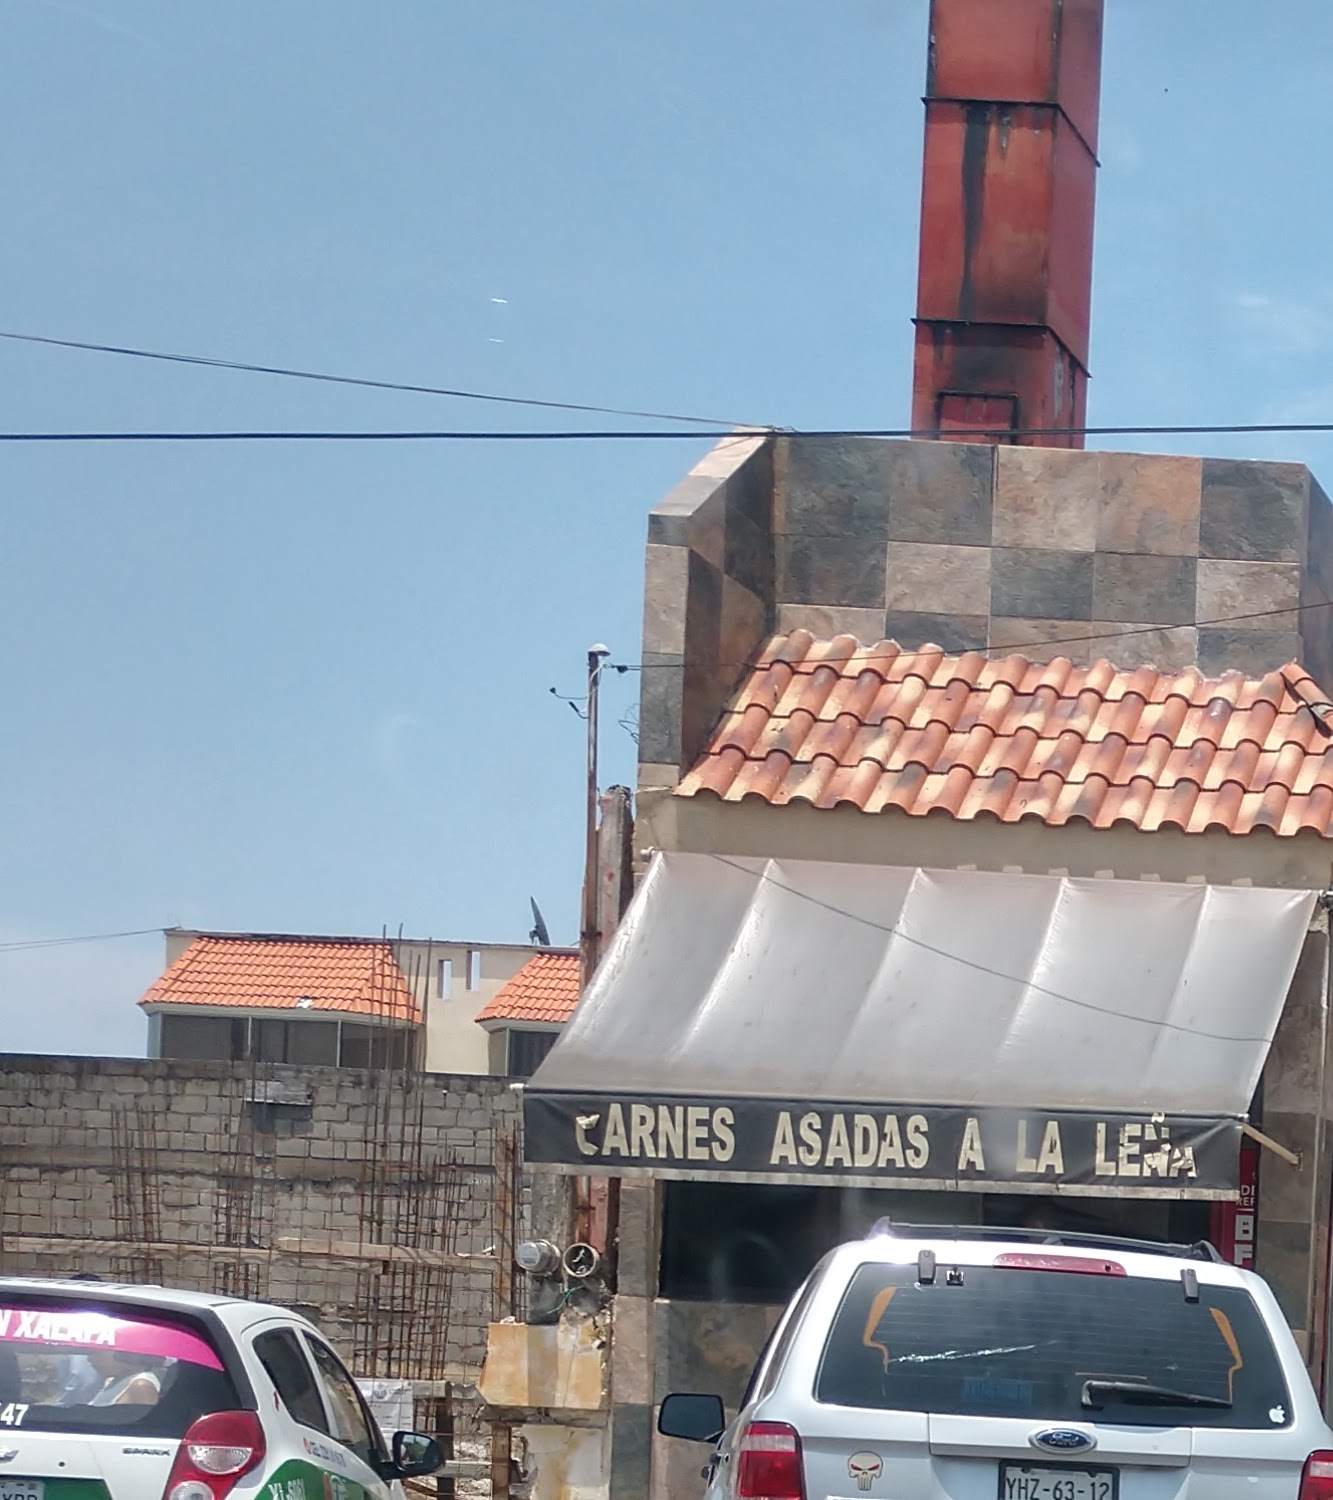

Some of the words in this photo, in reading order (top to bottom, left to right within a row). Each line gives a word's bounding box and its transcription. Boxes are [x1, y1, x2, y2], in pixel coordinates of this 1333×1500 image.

[576, 1103, 734, 1161] CARNES
[770, 1112, 930, 1169] ASADAS
[958, 1118, 985, 1171] A
[1016, 1120, 1064, 1174] LA
[1049, 1432, 1079, 1447] Ford
[122, 1447, 171, 1457] SPARK
